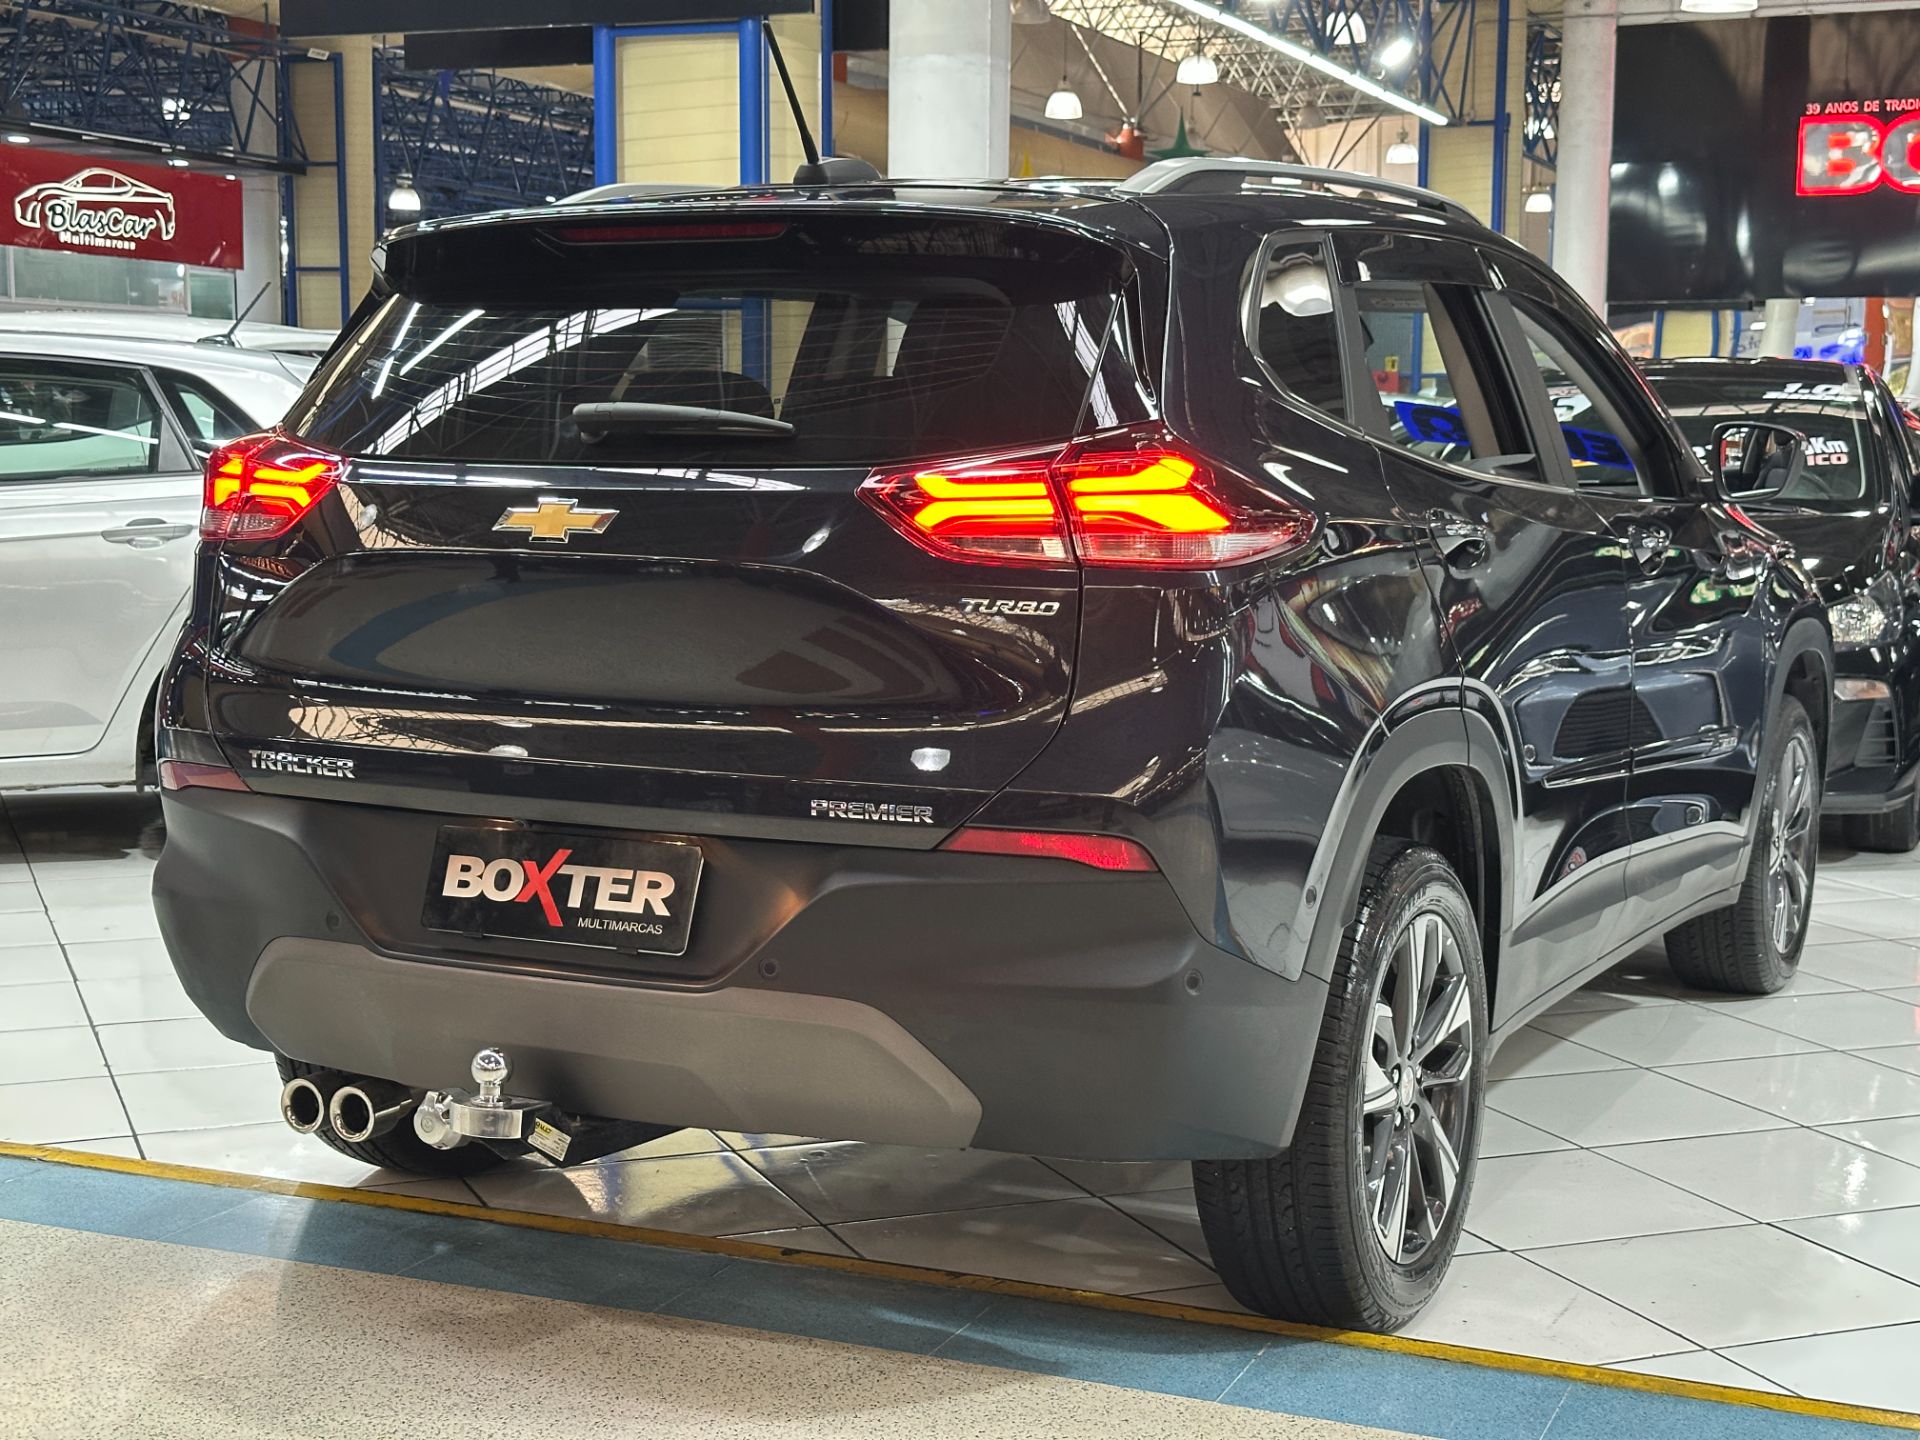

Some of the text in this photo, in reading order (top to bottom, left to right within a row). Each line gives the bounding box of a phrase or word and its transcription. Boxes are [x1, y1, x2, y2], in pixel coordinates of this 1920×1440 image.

[1806, 98, 1920, 115] 39 ANOS DE TRADI
[45, 200, 157, 240] BlasCar
[961, 597, 1060, 616] TURBO
[248, 749, 356, 779] TRACKER
[810, 799, 935, 825] PREMIER
[442, 848, 675, 927] BOXTER
[577, 916, 664, 936] MULTIMARCAS
